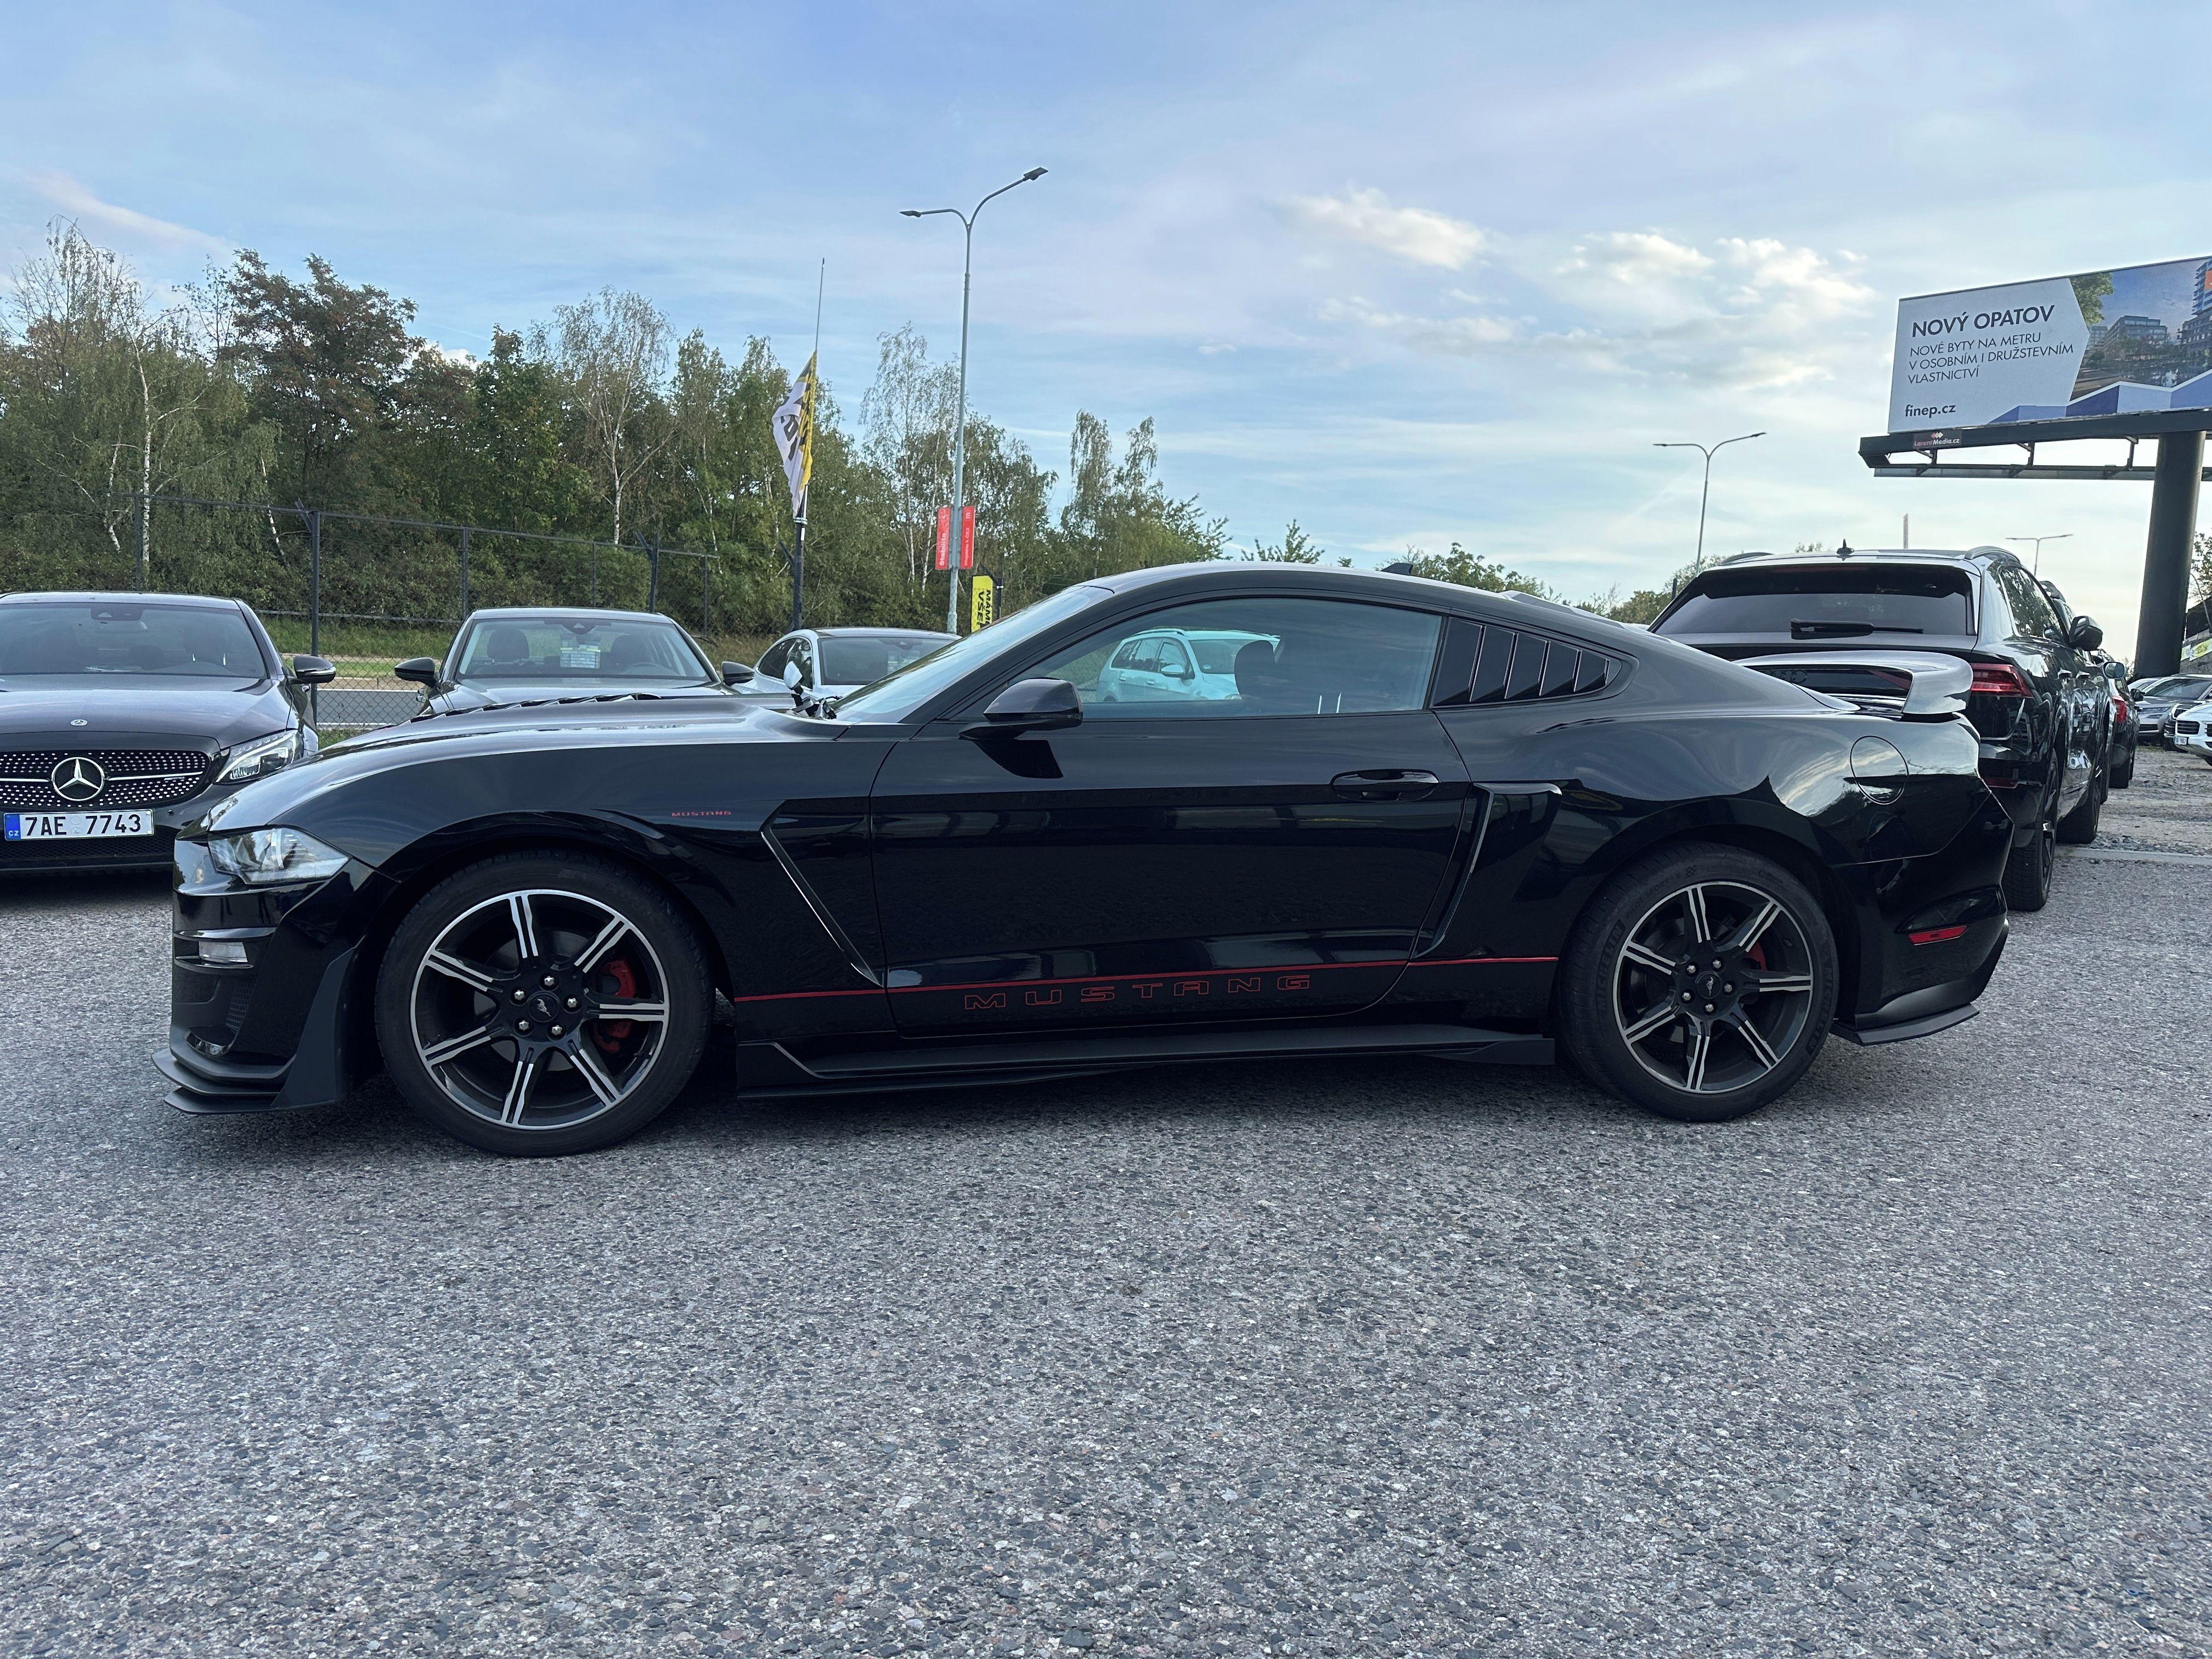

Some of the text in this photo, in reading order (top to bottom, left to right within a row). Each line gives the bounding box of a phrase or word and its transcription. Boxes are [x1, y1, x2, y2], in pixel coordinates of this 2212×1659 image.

[1912, 305, 2055, 337] NOVÝ OPATOV
[1909, 342, 2073, 370] V OSOBNÍM I DRUŽSTEVNÍM
[1910, 332, 2041, 357] NOVÉ BYTY NA METRU
[1908, 365, 1979, 384] VLASTNICTVÍ
[1905, 404, 1956, 419] finep.cz
[25, 816, 67, 836] 7AE
[86, 814, 141, 834] 7743
[1625, 897, 1643, 918] PILOT
[1645, 879, 1669, 899] SPORT
[1597, 923, 1624, 1011] MICHELIN
[964, 974, 1310, 1009] MUSTANG
